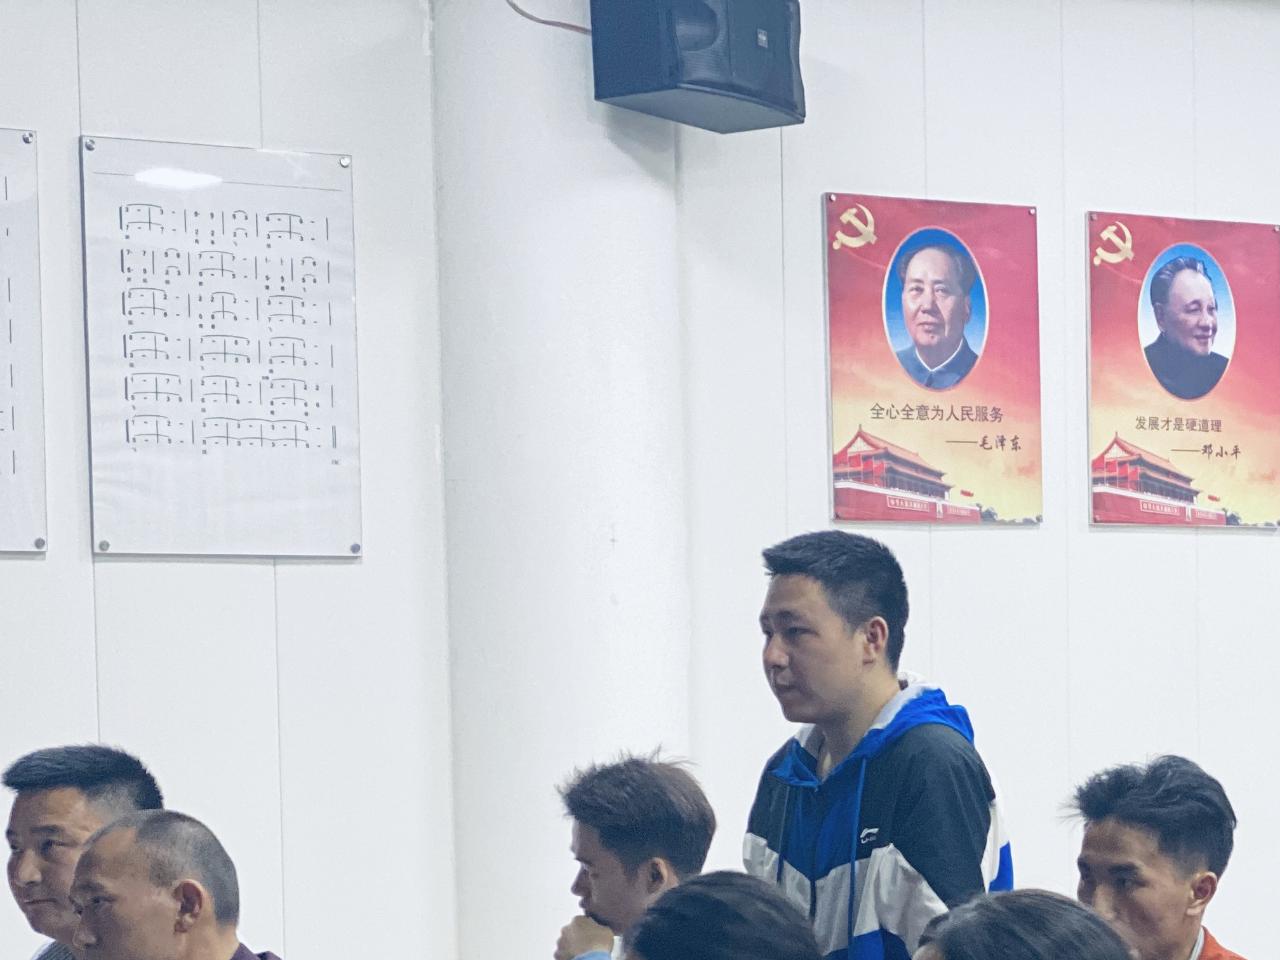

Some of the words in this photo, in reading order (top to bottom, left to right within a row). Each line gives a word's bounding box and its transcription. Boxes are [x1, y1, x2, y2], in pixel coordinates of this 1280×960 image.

[870, 402, 1003, 423] 全心全意为人民服务
[1135, 416, 1222, 433] 发展才是硬道理
